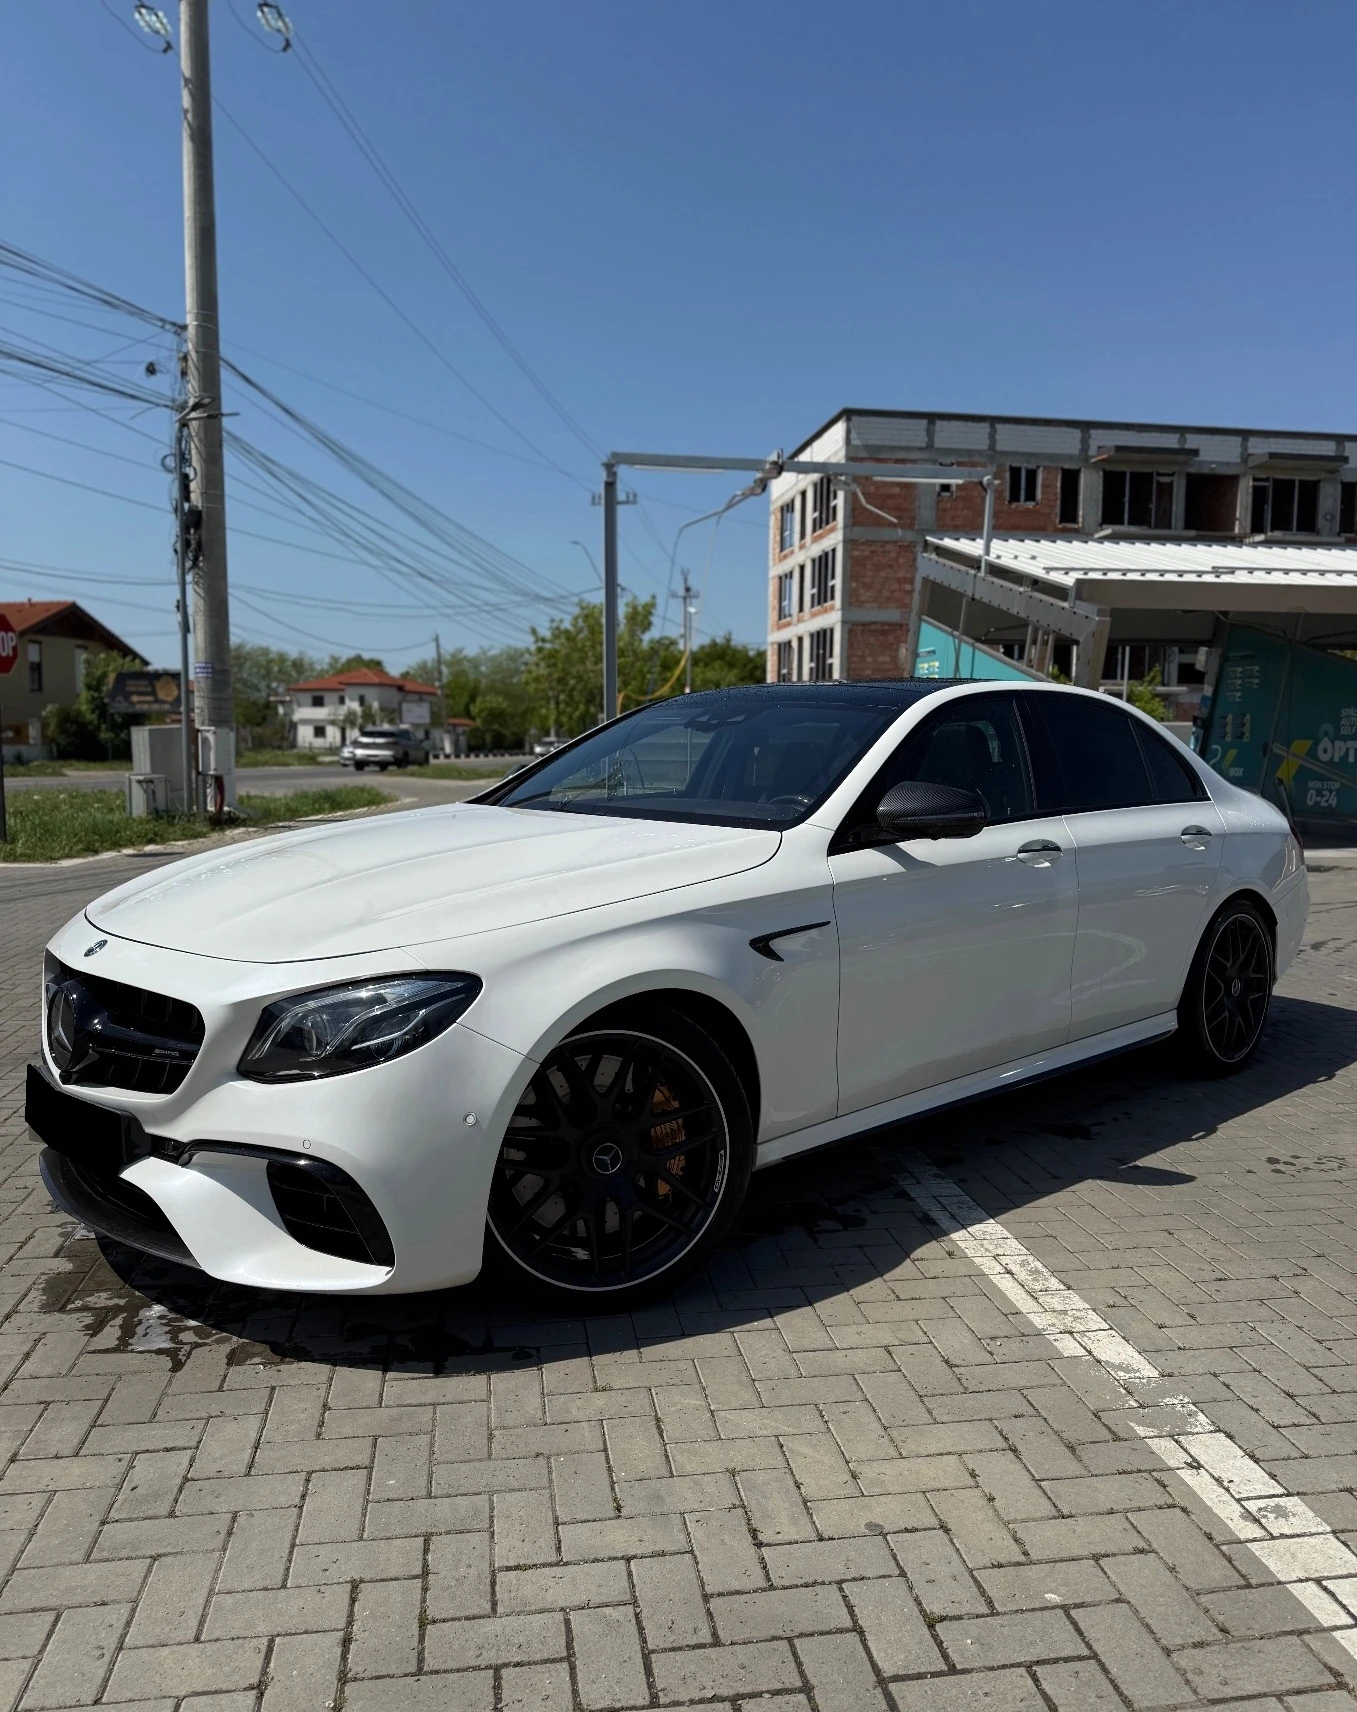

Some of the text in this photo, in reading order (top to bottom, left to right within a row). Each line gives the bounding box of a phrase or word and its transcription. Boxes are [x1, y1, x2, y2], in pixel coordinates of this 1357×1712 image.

[1307, 780, 1341, 790] NON STOP
[1306, 789, 1338, 808] 0-24
